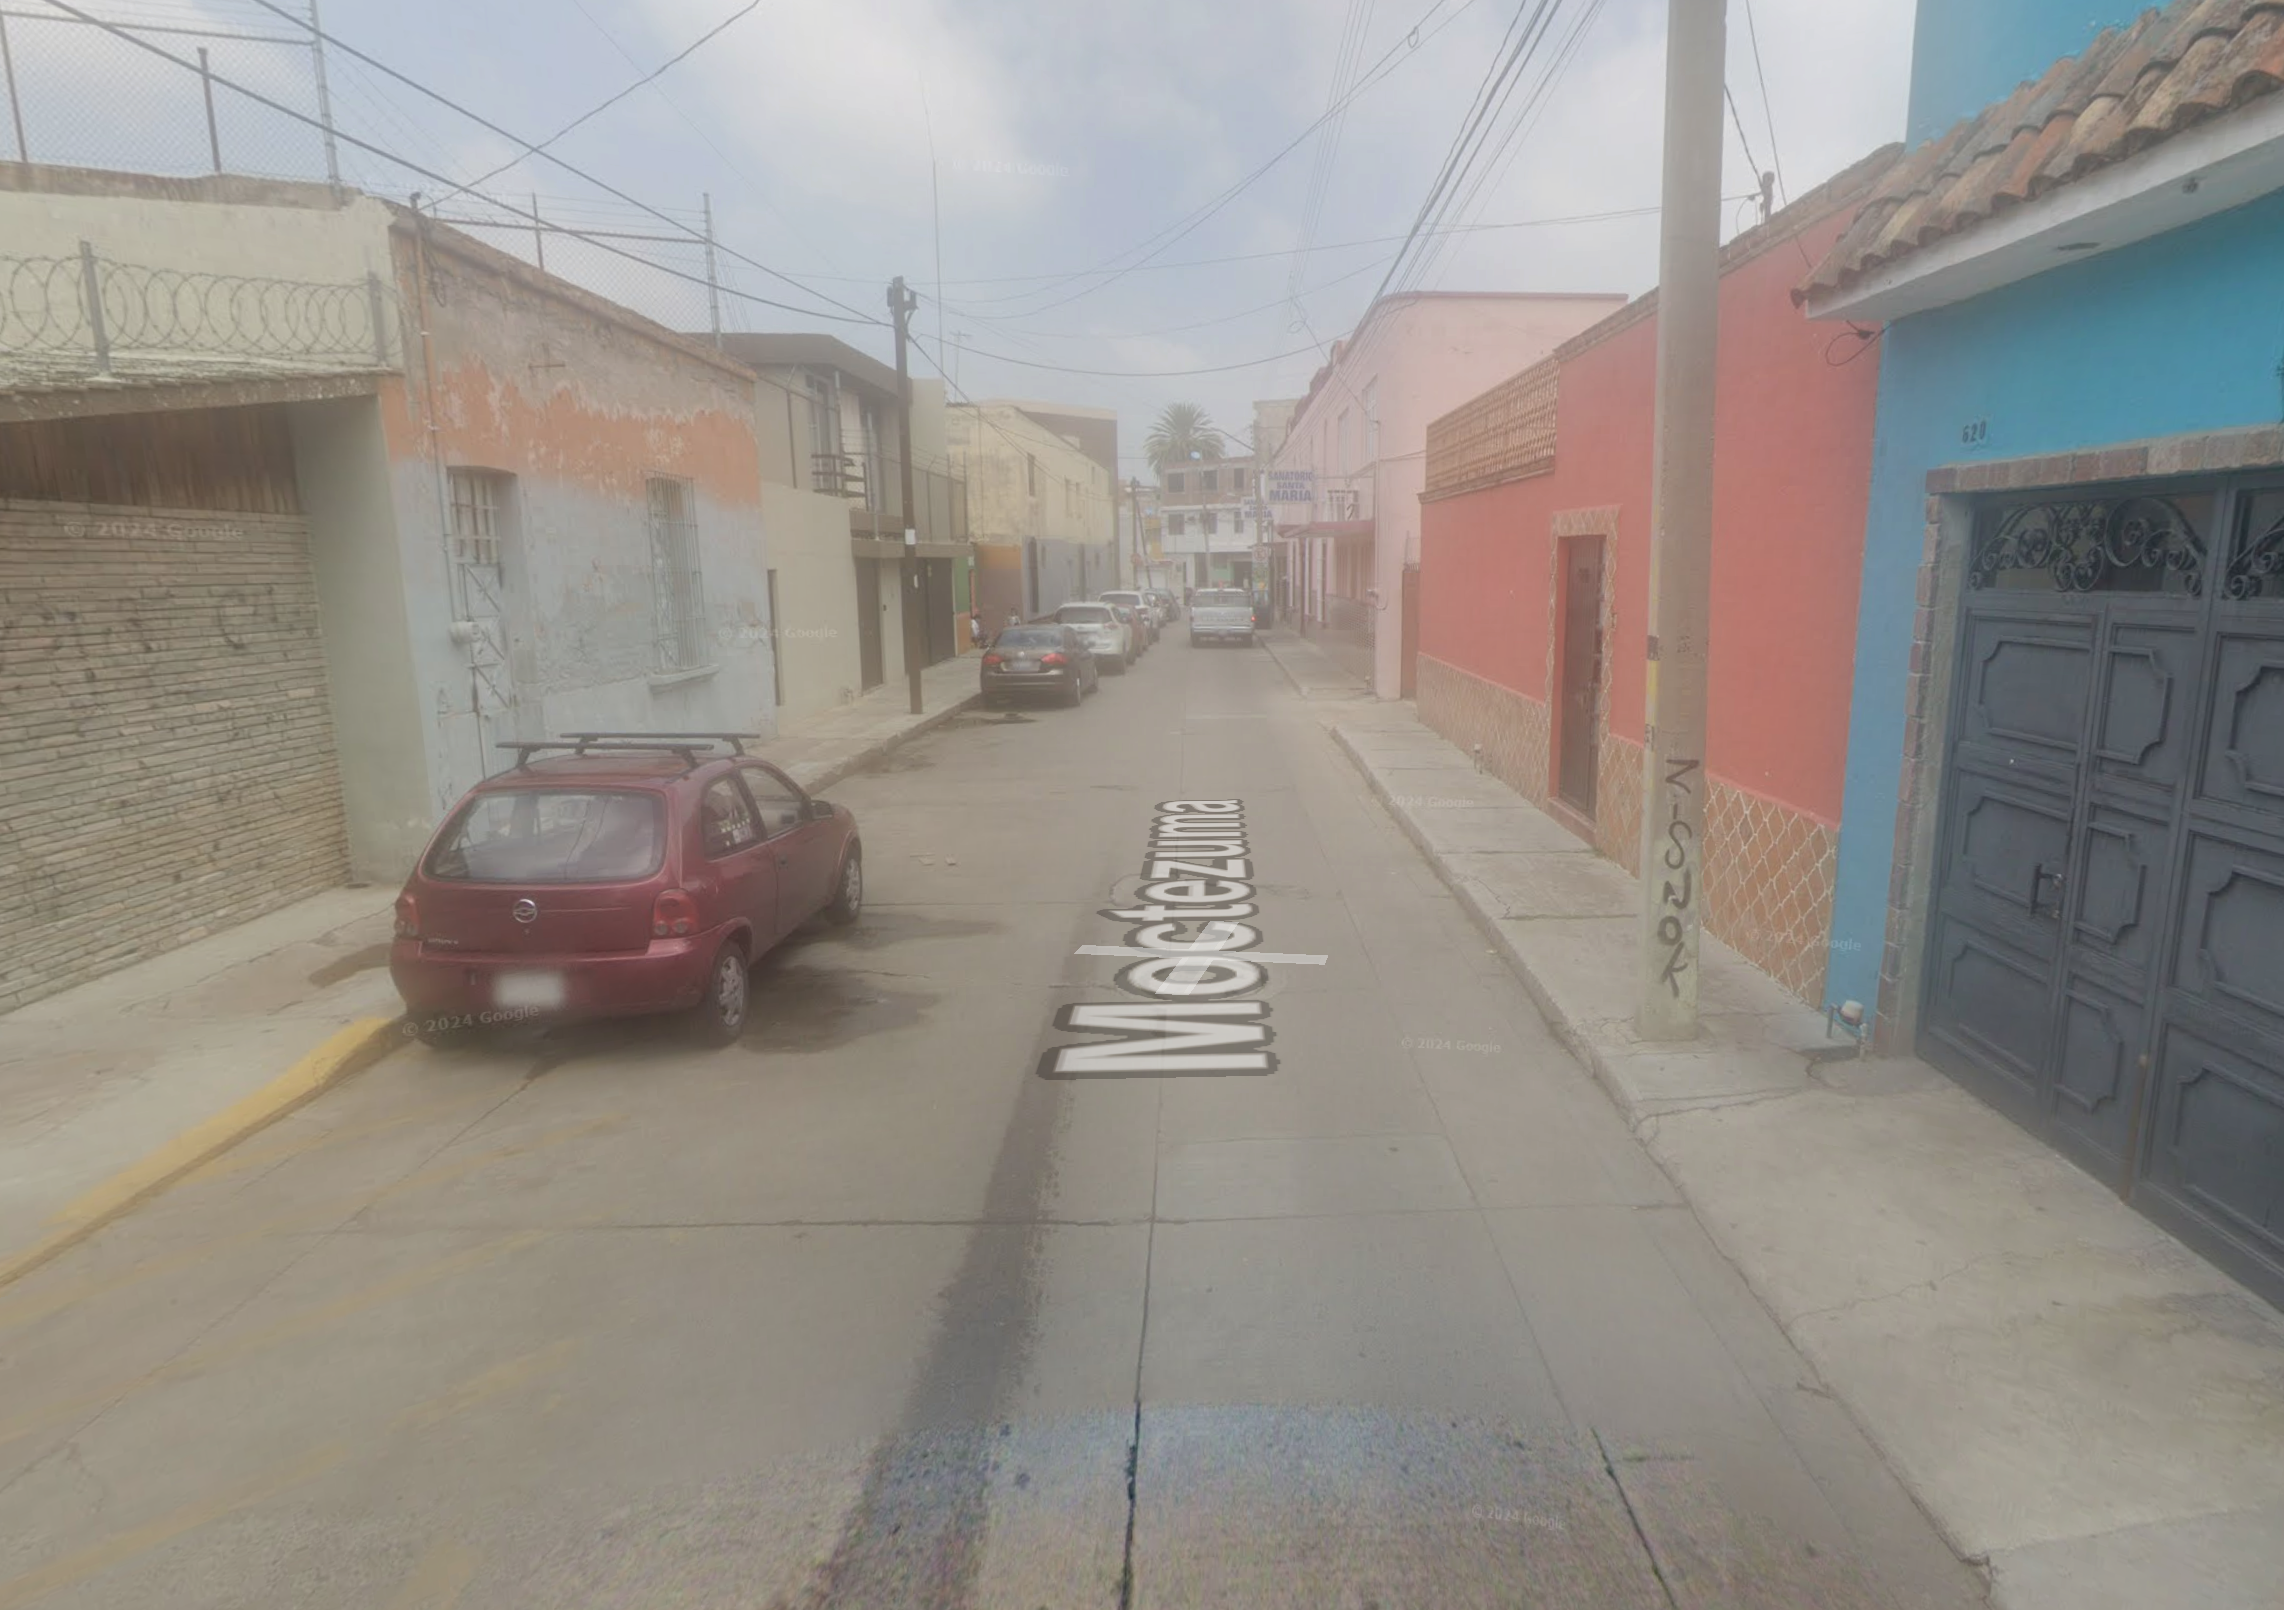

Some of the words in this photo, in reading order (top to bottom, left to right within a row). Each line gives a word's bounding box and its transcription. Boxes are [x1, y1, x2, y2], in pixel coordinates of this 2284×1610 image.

[1962, 420, 1987, 444] 620
[1277, 481, 1305, 489] SANTA
[1269, 490, 1312, 501] MARIA
[1244, 510, 1273, 518] MAIA
